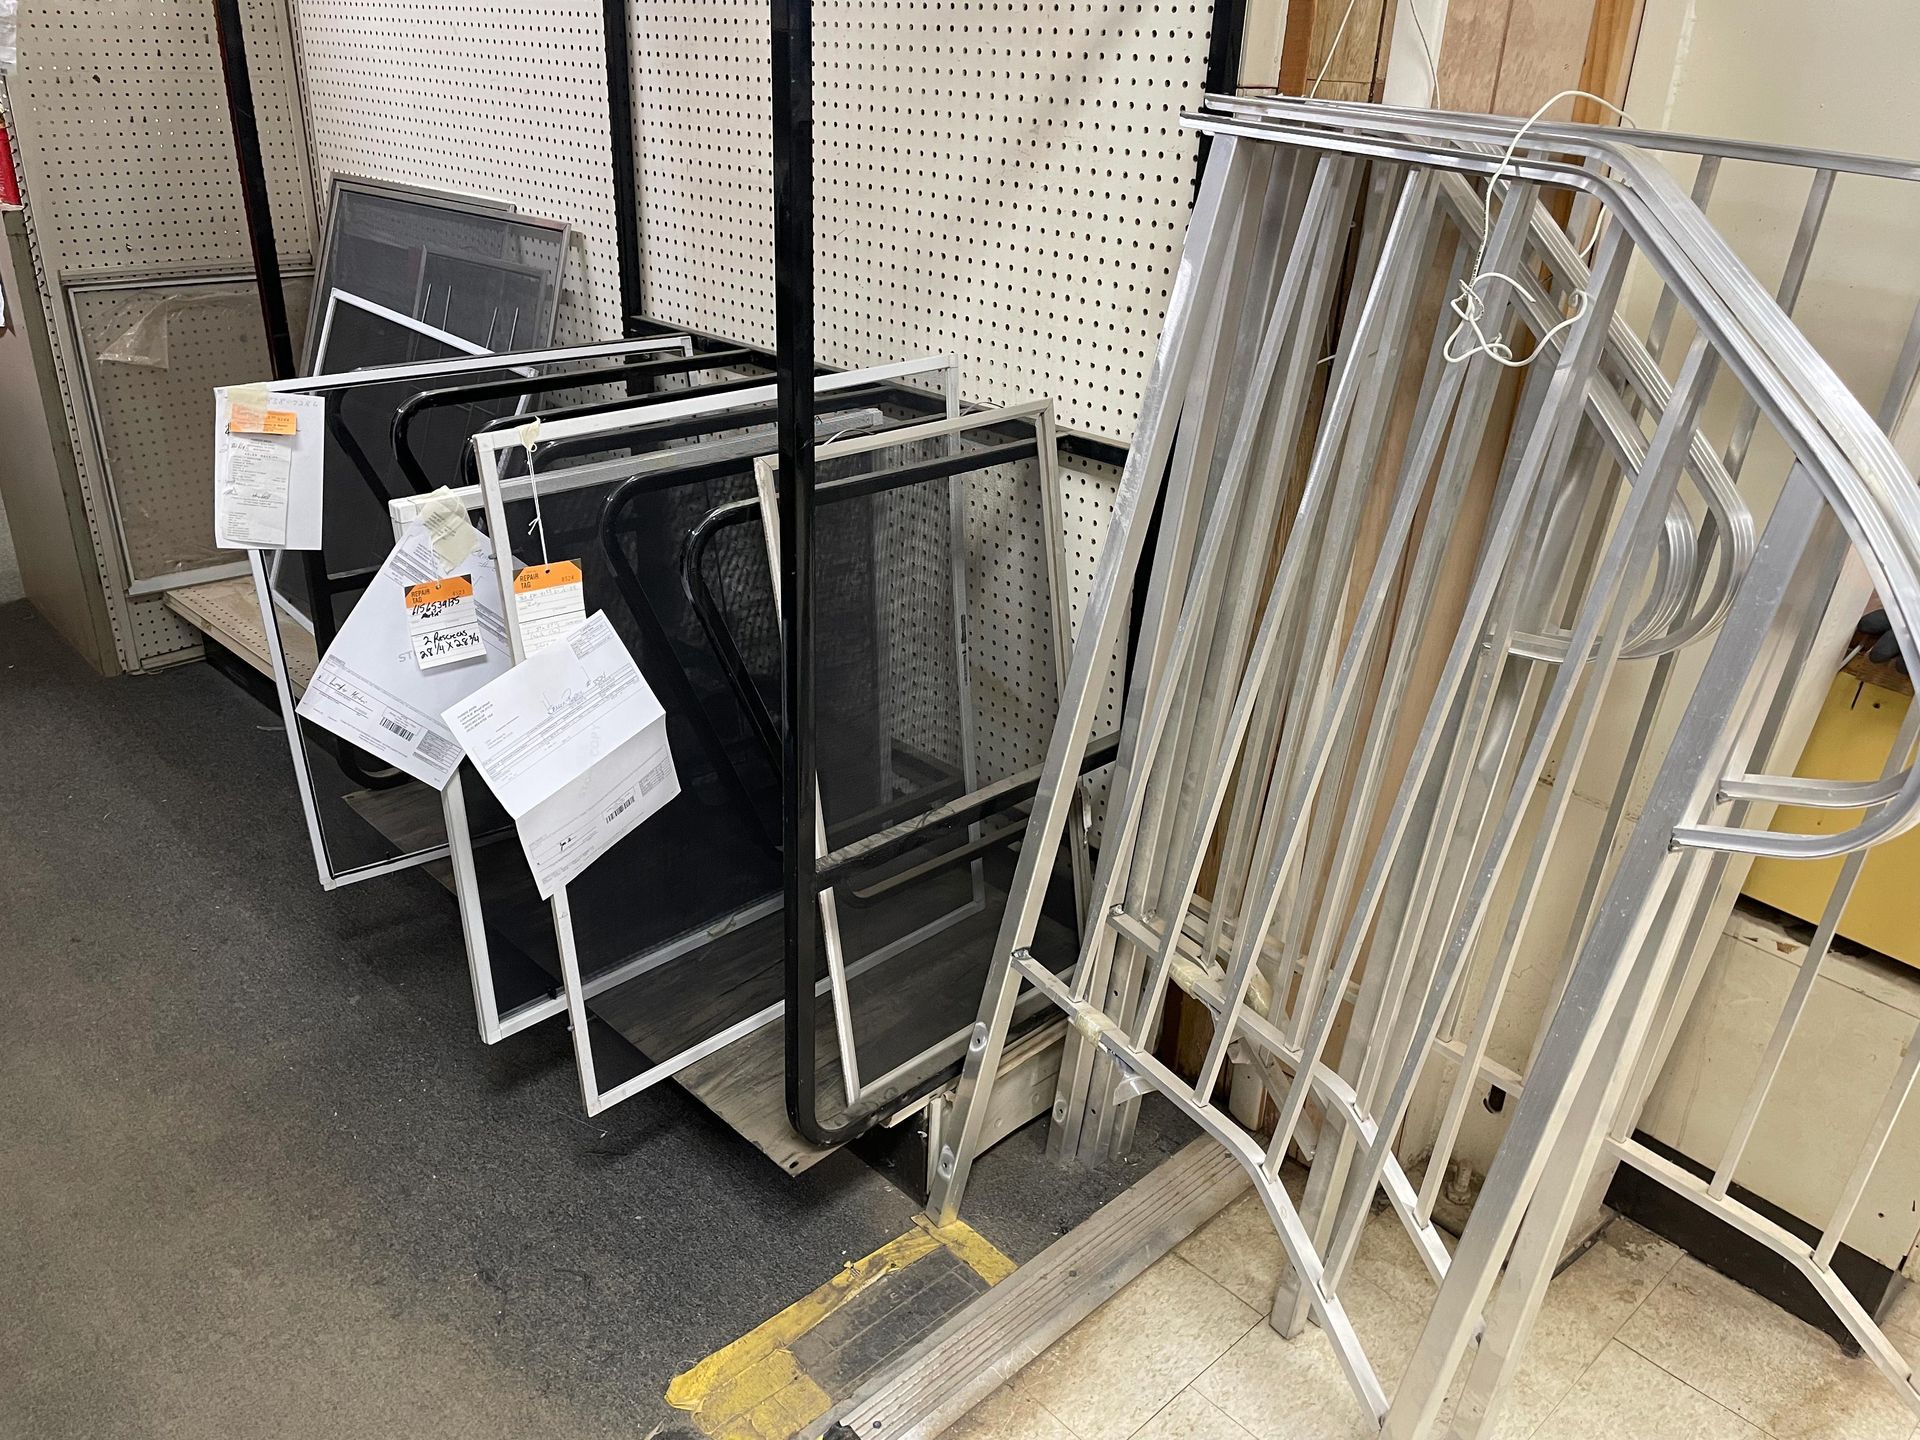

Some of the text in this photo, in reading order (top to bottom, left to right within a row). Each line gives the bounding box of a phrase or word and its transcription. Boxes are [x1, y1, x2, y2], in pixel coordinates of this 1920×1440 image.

[520, 573, 539, 582] REPAIR
[411, 589, 430, 597] REPAIR
[423, 636, 432, 645] 2
[420, 647, 433, 659] 28
[454, 637, 468, 647] 28
[469, 632, 480, 645] 3/4
